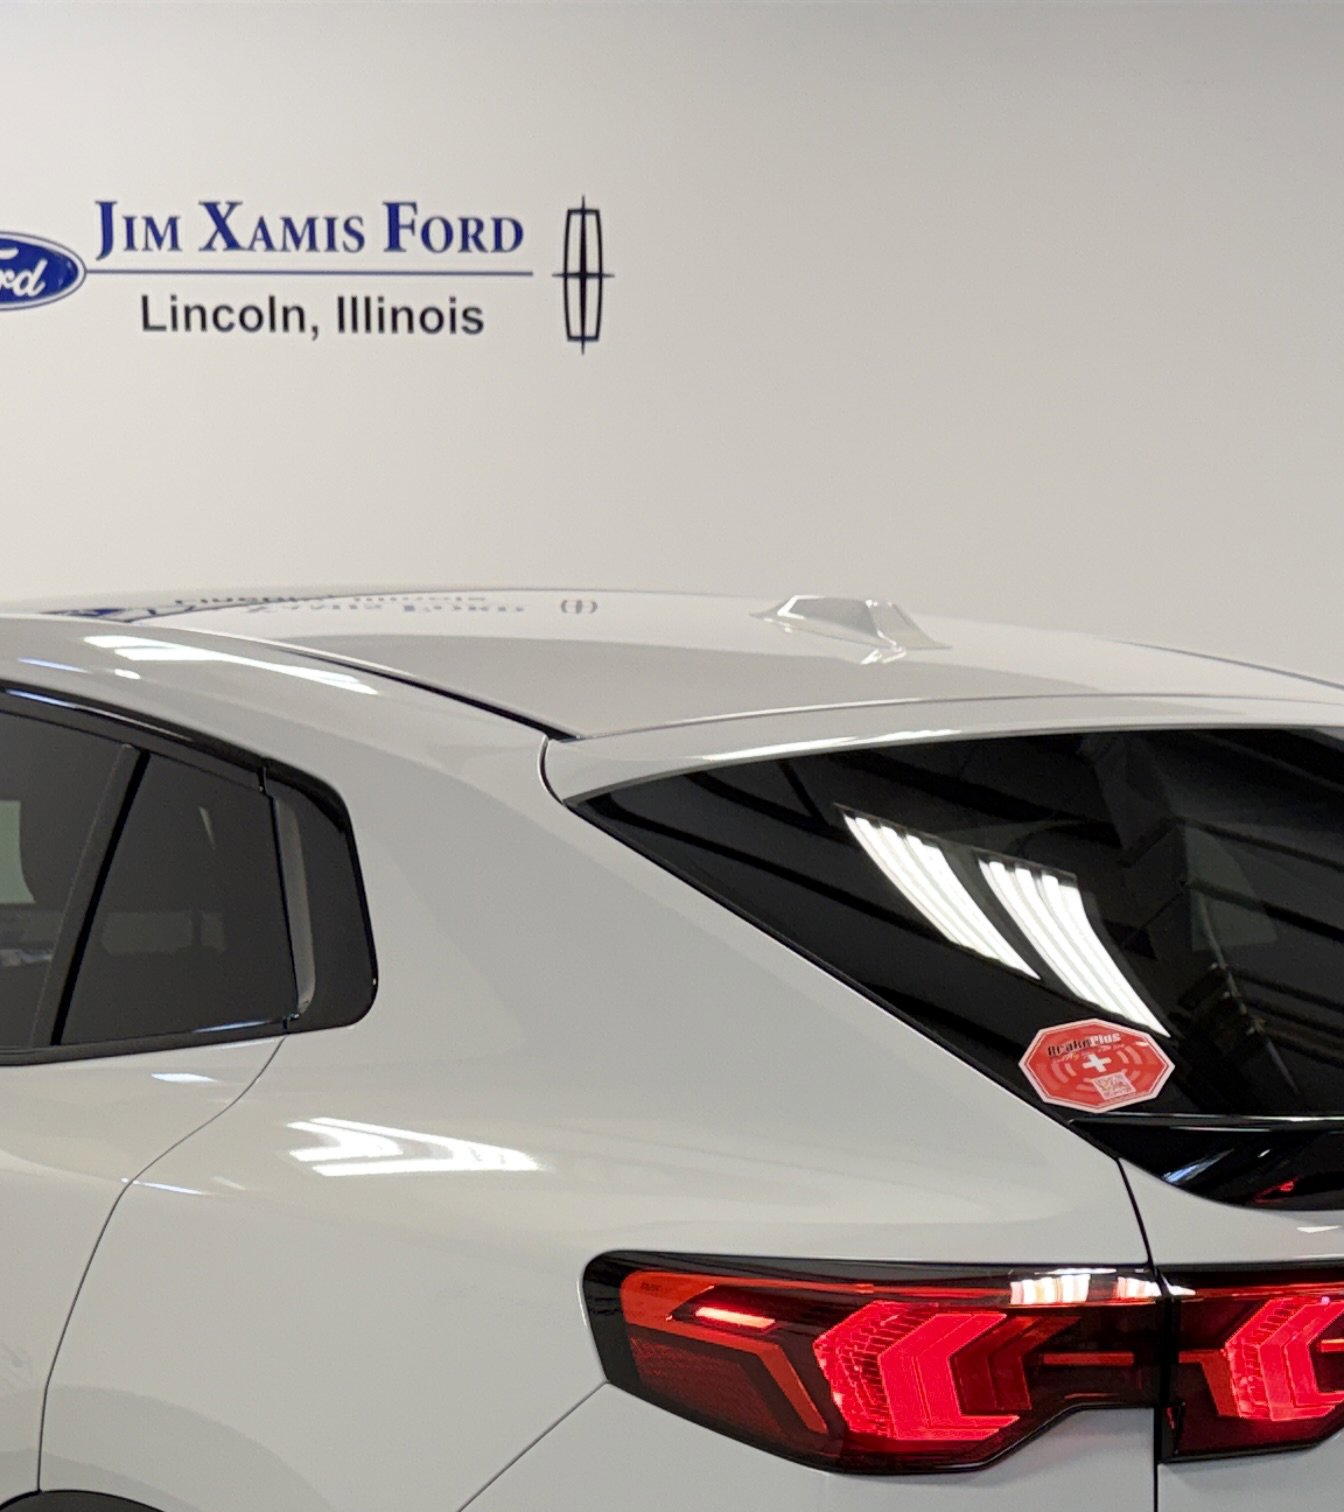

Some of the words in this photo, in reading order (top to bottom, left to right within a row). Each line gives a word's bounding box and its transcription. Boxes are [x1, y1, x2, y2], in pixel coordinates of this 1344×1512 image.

[95, 200, 182, 261] JIM
[198, 200, 367, 254] XAMIS
[382, 200, 525, 254] FORD
[141, 294, 320, 341] Lincoln,
[337, 294, 485, 335] Illinois
